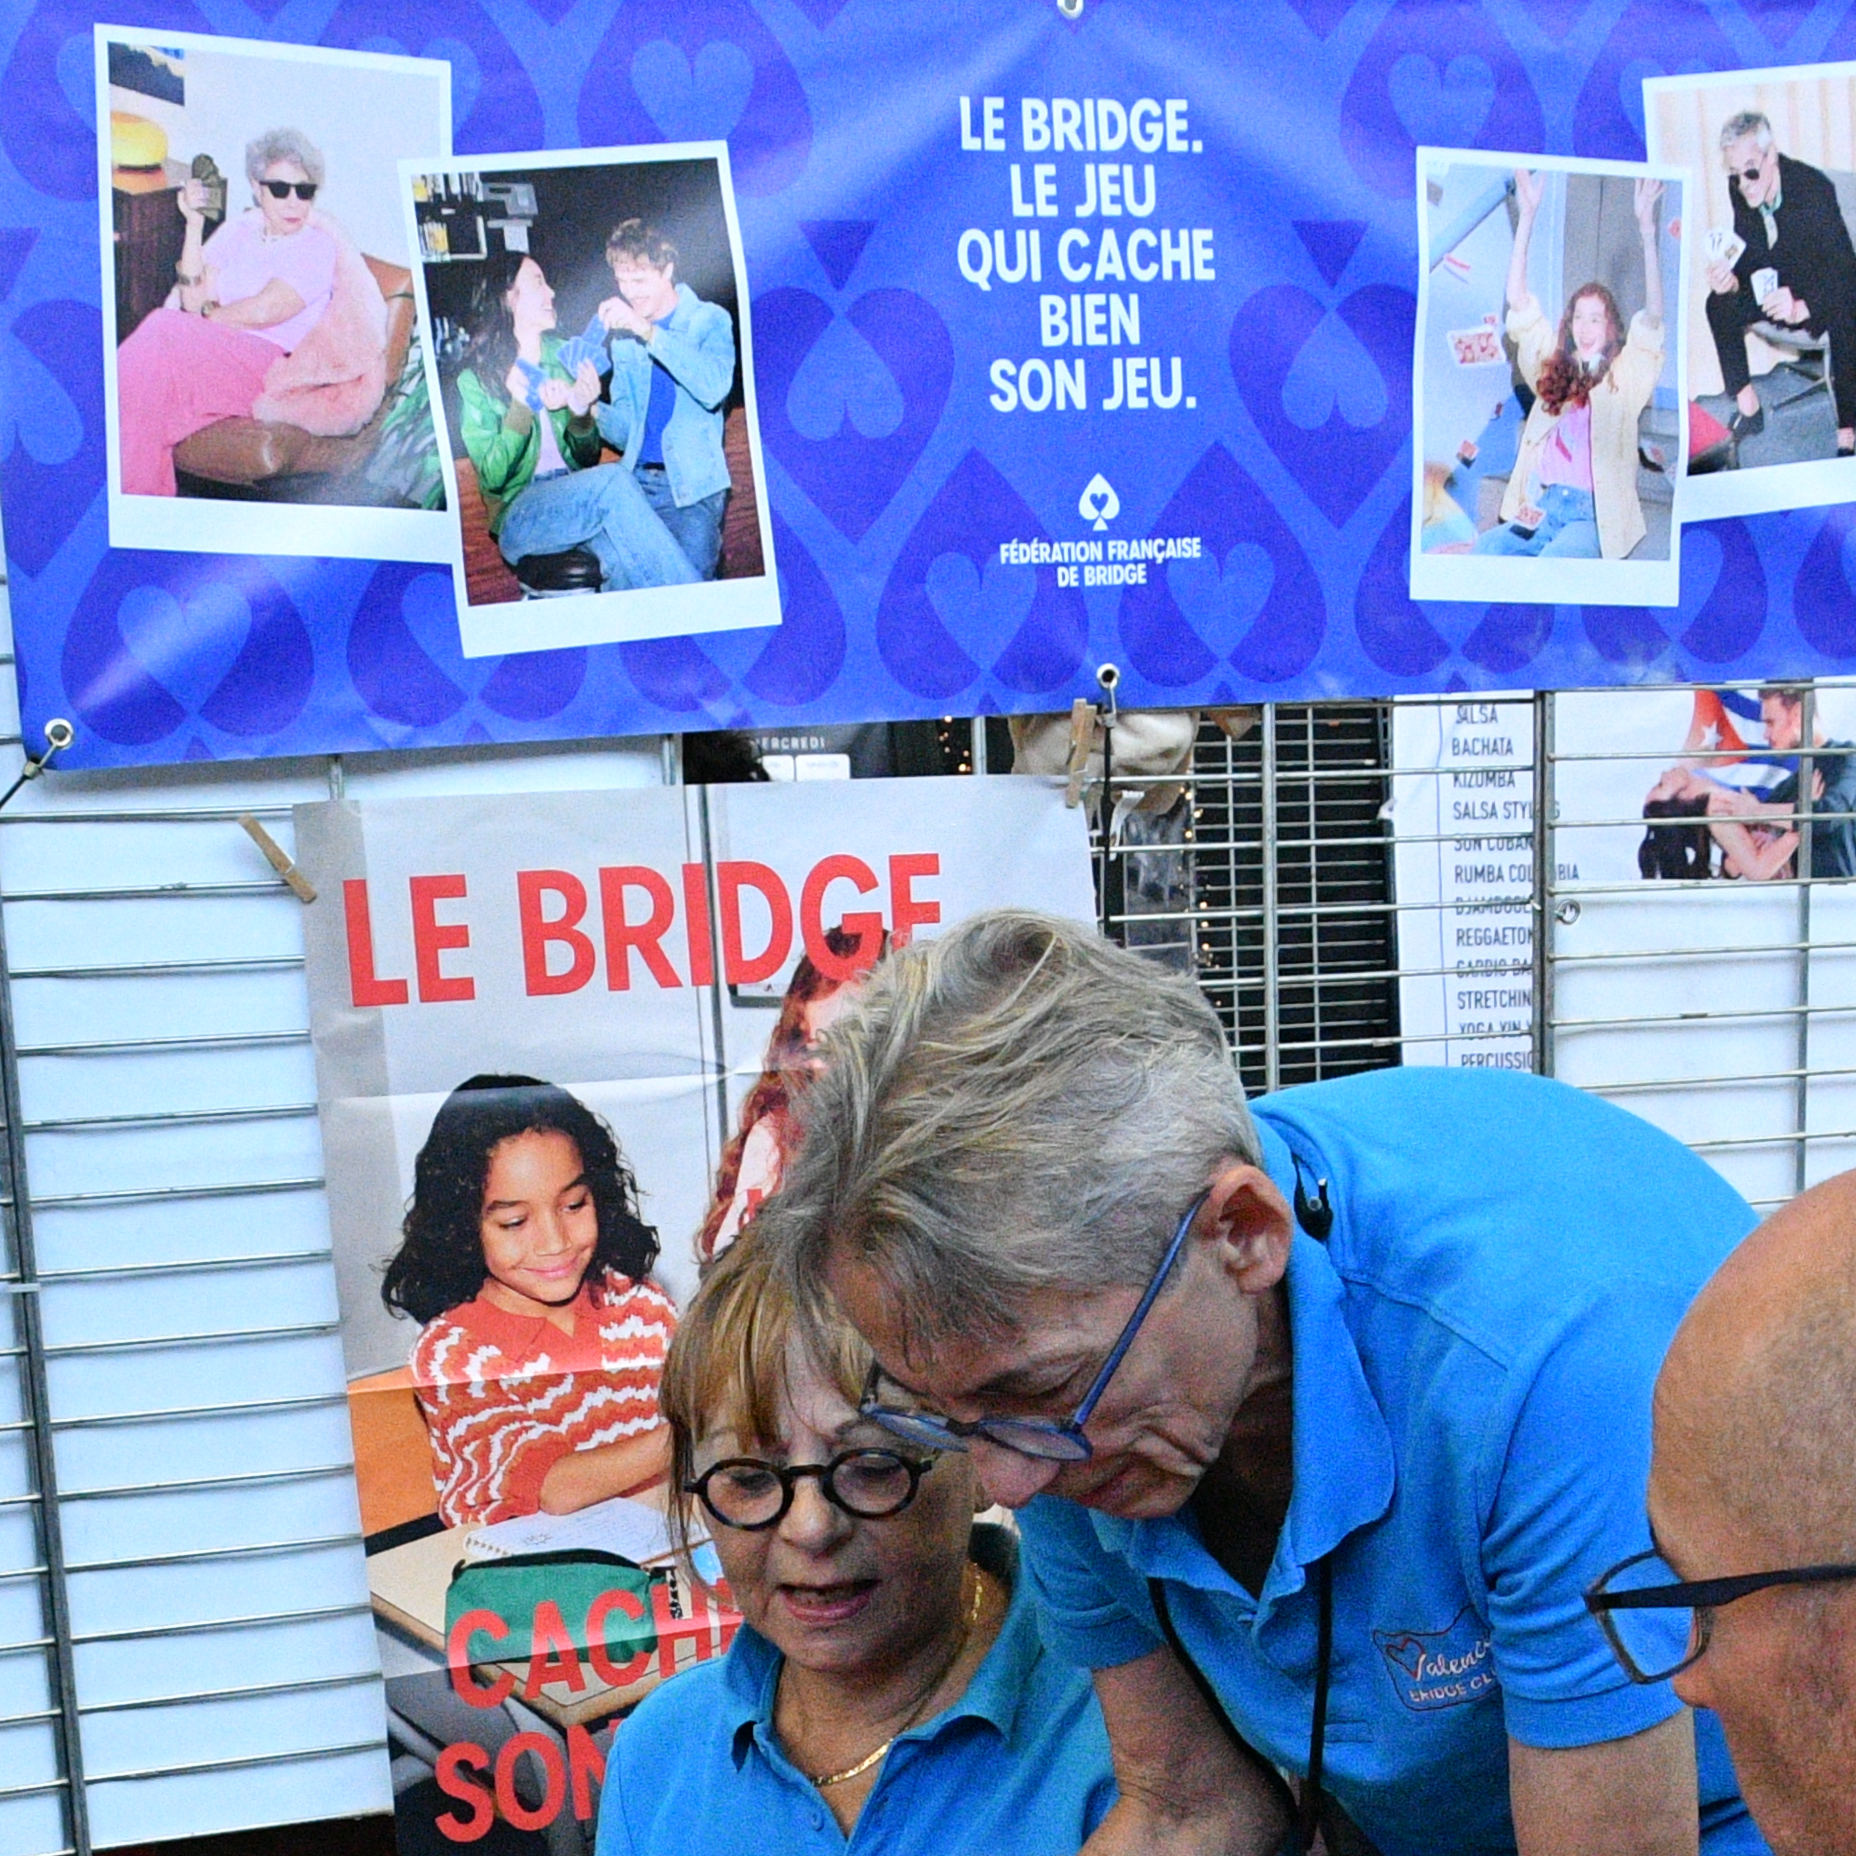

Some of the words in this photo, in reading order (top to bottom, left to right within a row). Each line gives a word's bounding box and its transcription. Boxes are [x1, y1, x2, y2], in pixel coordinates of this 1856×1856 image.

[960, 97, 1005, 150] LE
[1022, 98, 1203, 153] BRIDGE.
[1010, 164, 1058, 217] LE
[1075, 164, 1156, 217] JEU
[957, 228, 1041, 291] QUI
[1058, 228, 1216, 281] CACHE
[1040, 294, 1140, 346] BIEN
[989, 358, 1086, 411] SON
[1103, 357, 1196, 410] JEU.
[1000, 538, 1103, 564] FÉDÉRATION
[1107, 537, 1202, 564] FRANÇAISE
[1057, 566, 1079, 588] DE
[1084, 563, 1147, 586] BRIDGE
[755, 736, 825, 750] ERCREDI
[1452, 737, 1514, 756] BACHATA
[1453, 771, 1516, 789] KIZUMBA
[1453, 801, 1499, 820] SALSA
[1503, 800, 1561, 820] STYLG
[1455, 864, 1505, 883] RUMBA
[1509, 863, 1580, 882] COLBIA
[343, 874, 476, 1007] LE
[516, 853, 942, 997] BRIDGE
[1414, 1640, 1491, 1682] Valenc
[1470, 1667, 1496, 1690] CL
